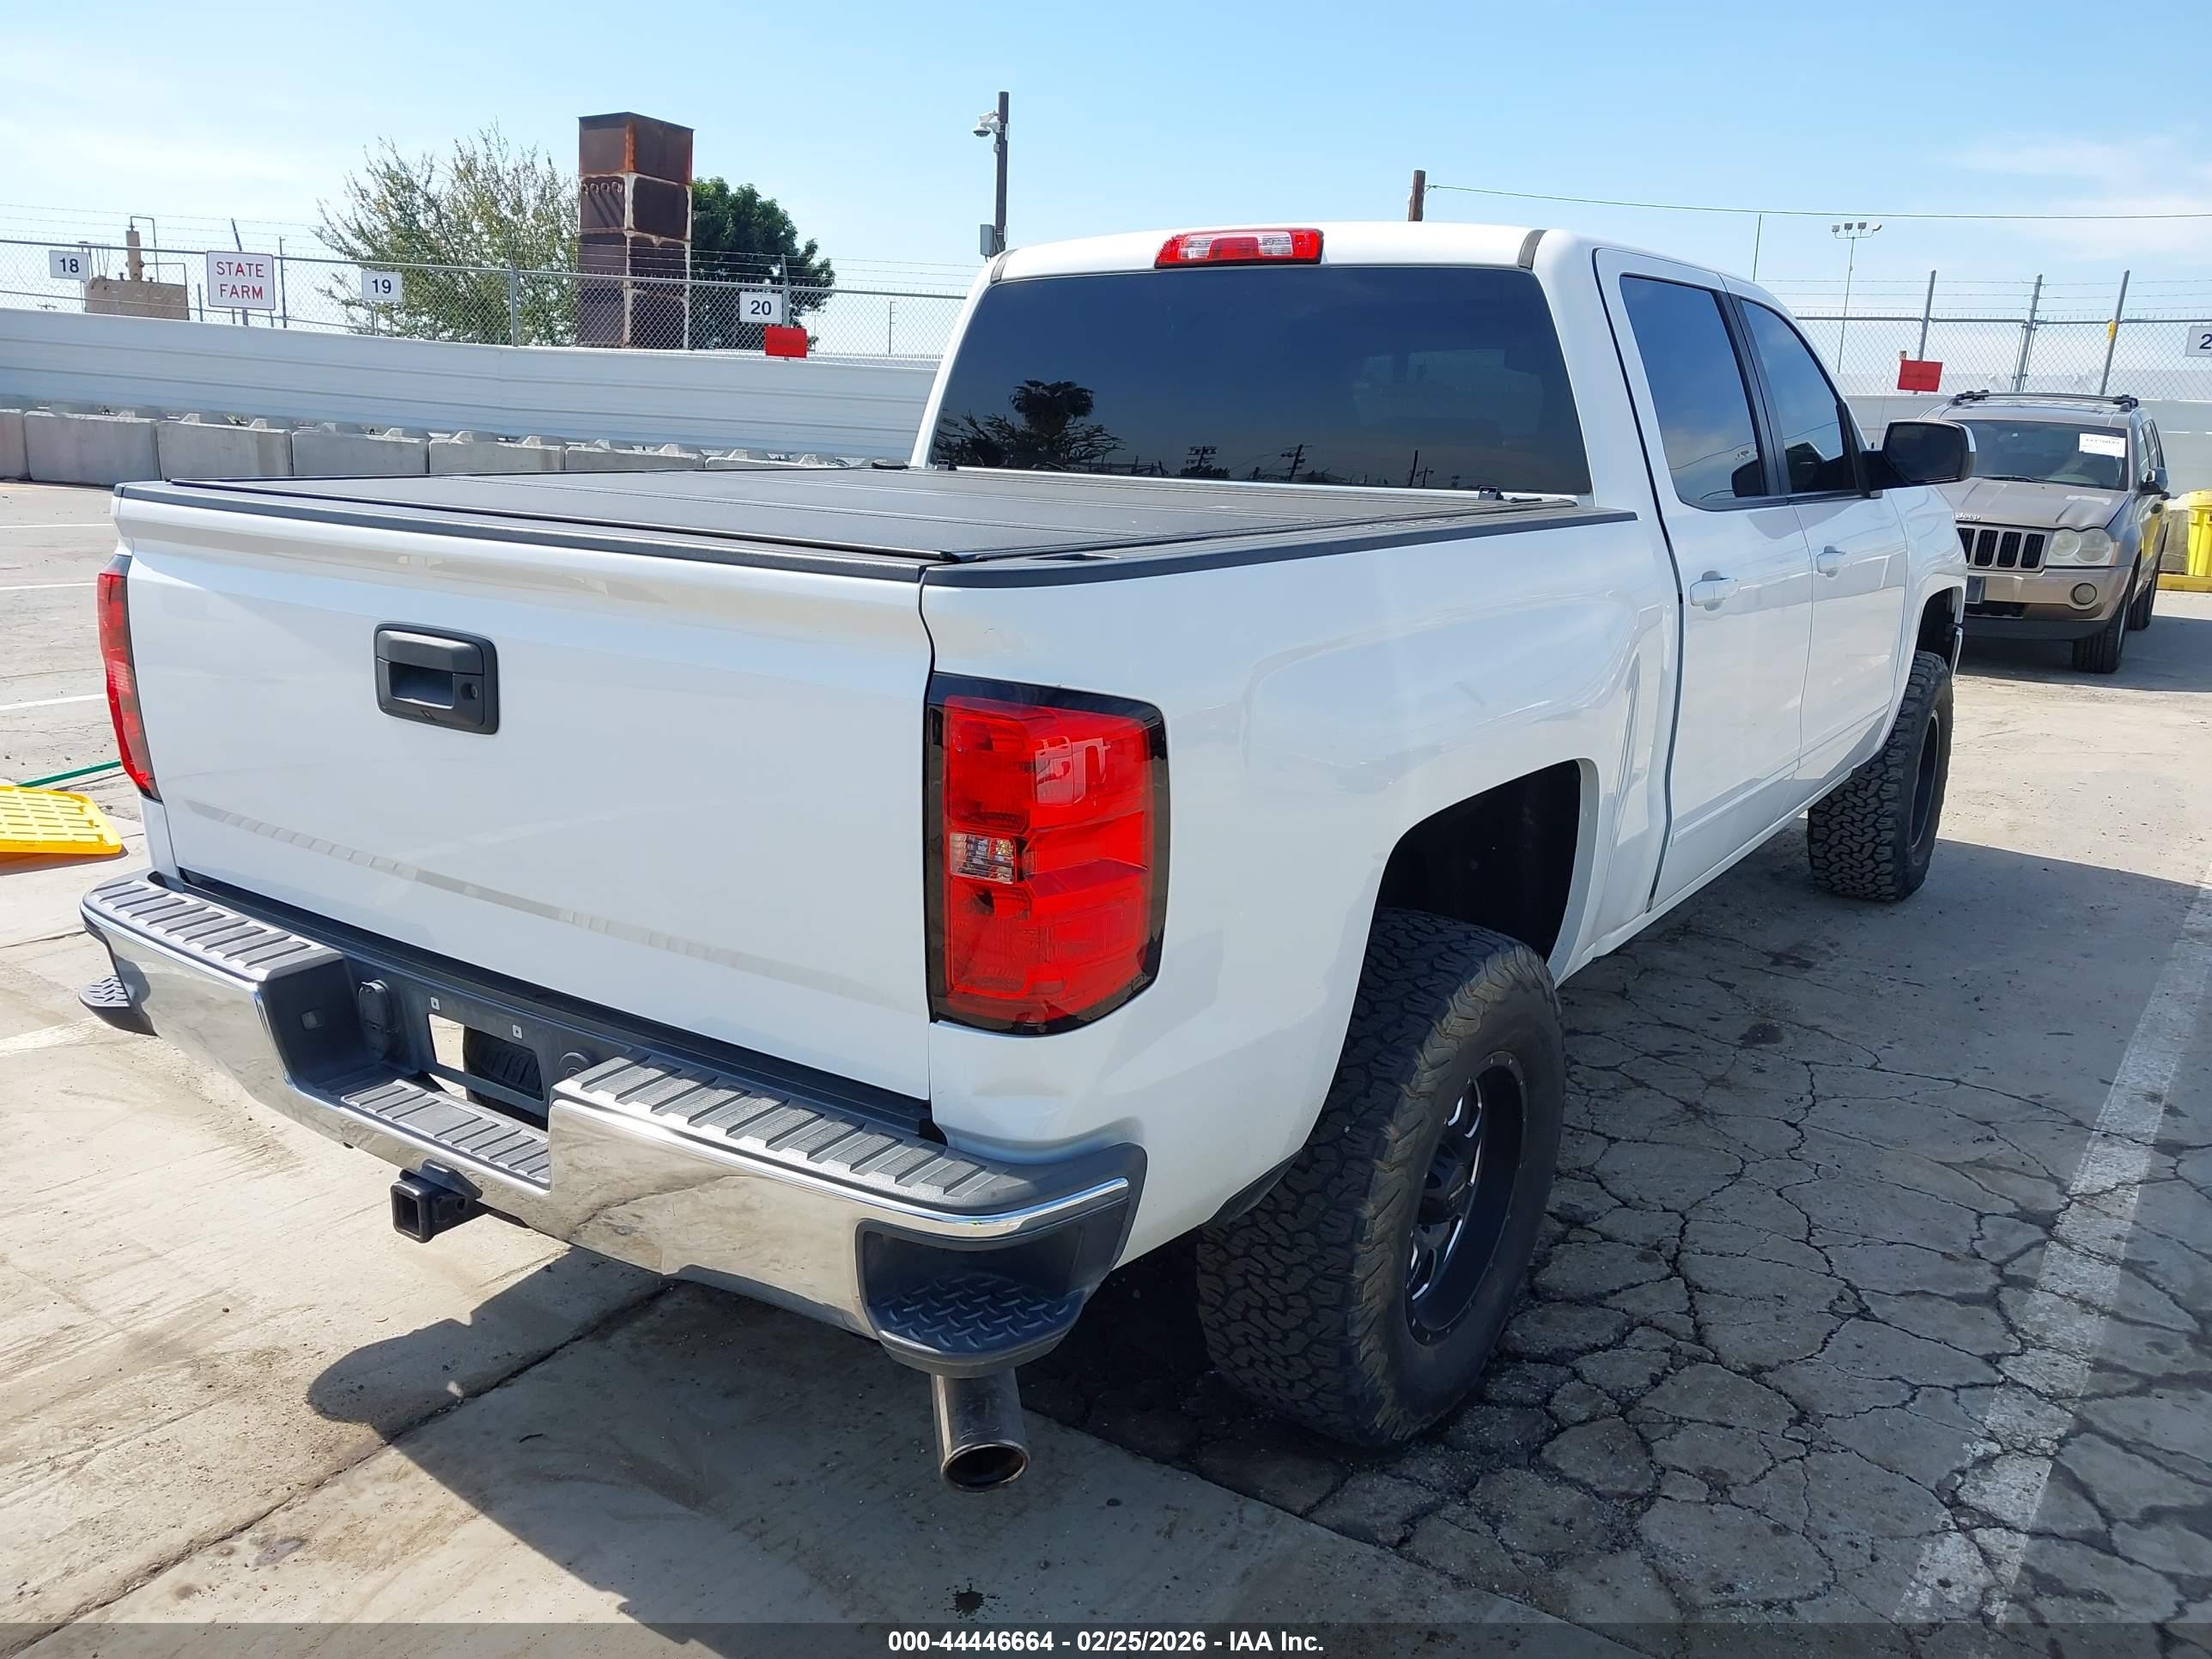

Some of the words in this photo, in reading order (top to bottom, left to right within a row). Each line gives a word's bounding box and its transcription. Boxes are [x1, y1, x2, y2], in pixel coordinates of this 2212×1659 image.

[58, 258, 80, 274] 18
[216, 261, 265, 278] STATE
[219, 283, 264, 301] FARM
[371, 279, 392, 295] 19
[750, 300, 772, 316] 20
